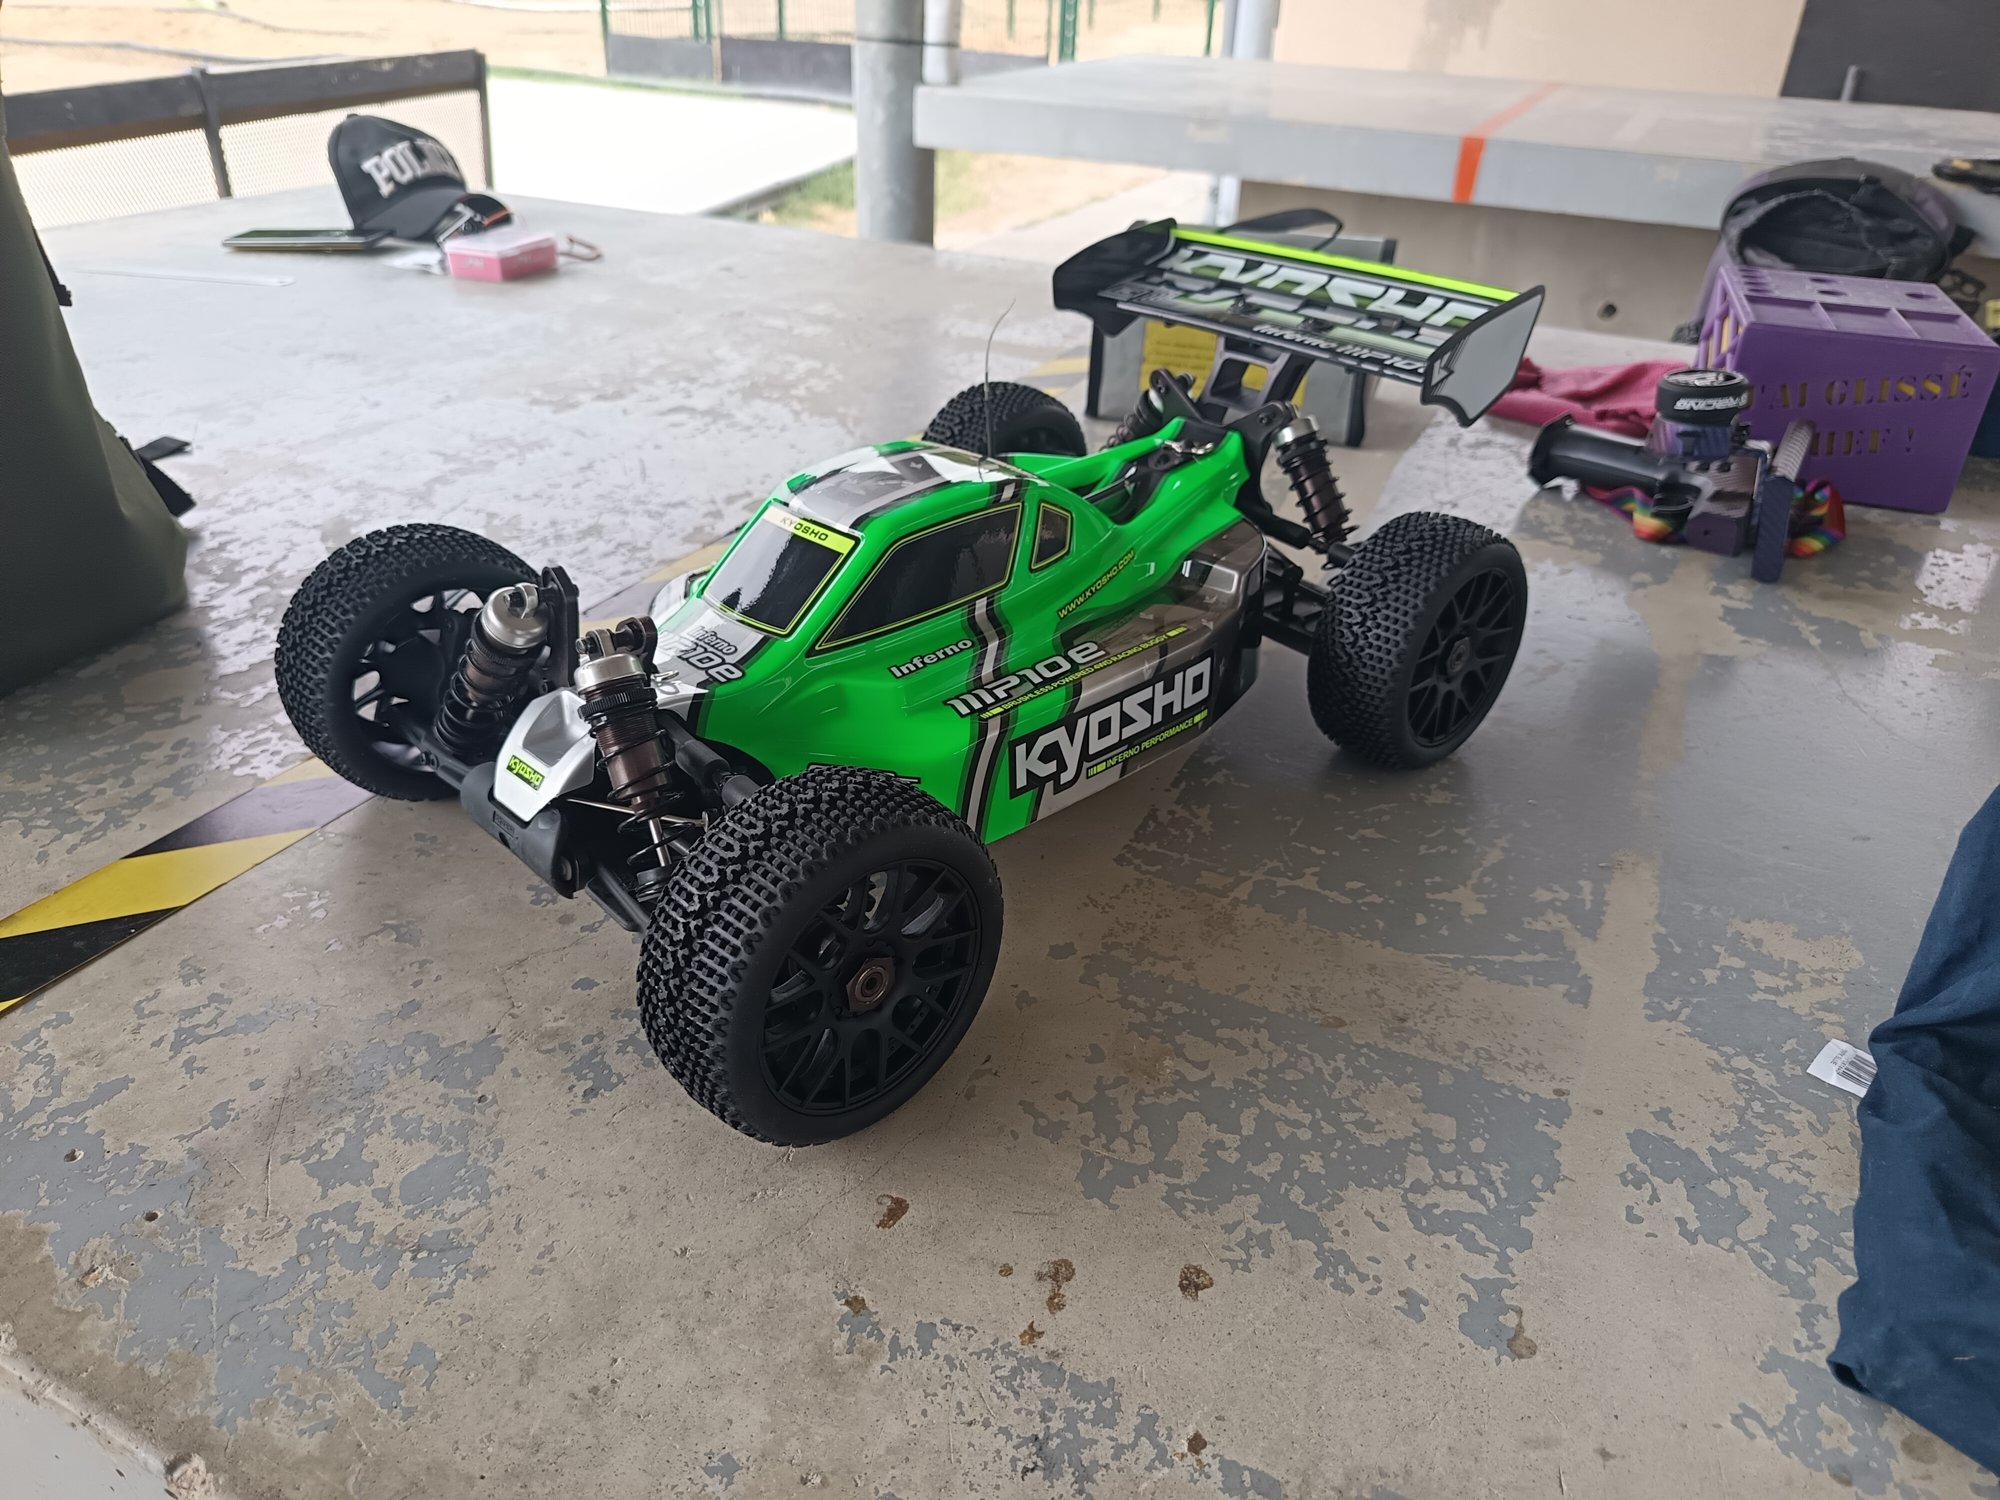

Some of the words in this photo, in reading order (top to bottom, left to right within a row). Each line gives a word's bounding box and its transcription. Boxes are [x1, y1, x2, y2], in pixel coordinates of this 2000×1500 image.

[1824, 363, 1972, 406] GLISSÉ
[780, 516, 829, 541] KYOSHO
[890, 639, 973, 678] Inferno
[1001, 682, 1054, 710] BRUSHLESS
[1052, 666, 1095, 688] POWERED
[1111, 646, 1142, 662] RACING
[1140, 633, 1169, 649] BUGGY
[1015, 656, 1212, 790] KYOSHO
[1106, 745, 1141, 768] INFERNO
[1141, 717, 1194, 751] PERFORMANCE
[509, 756, 543, 786] KYOSHO
